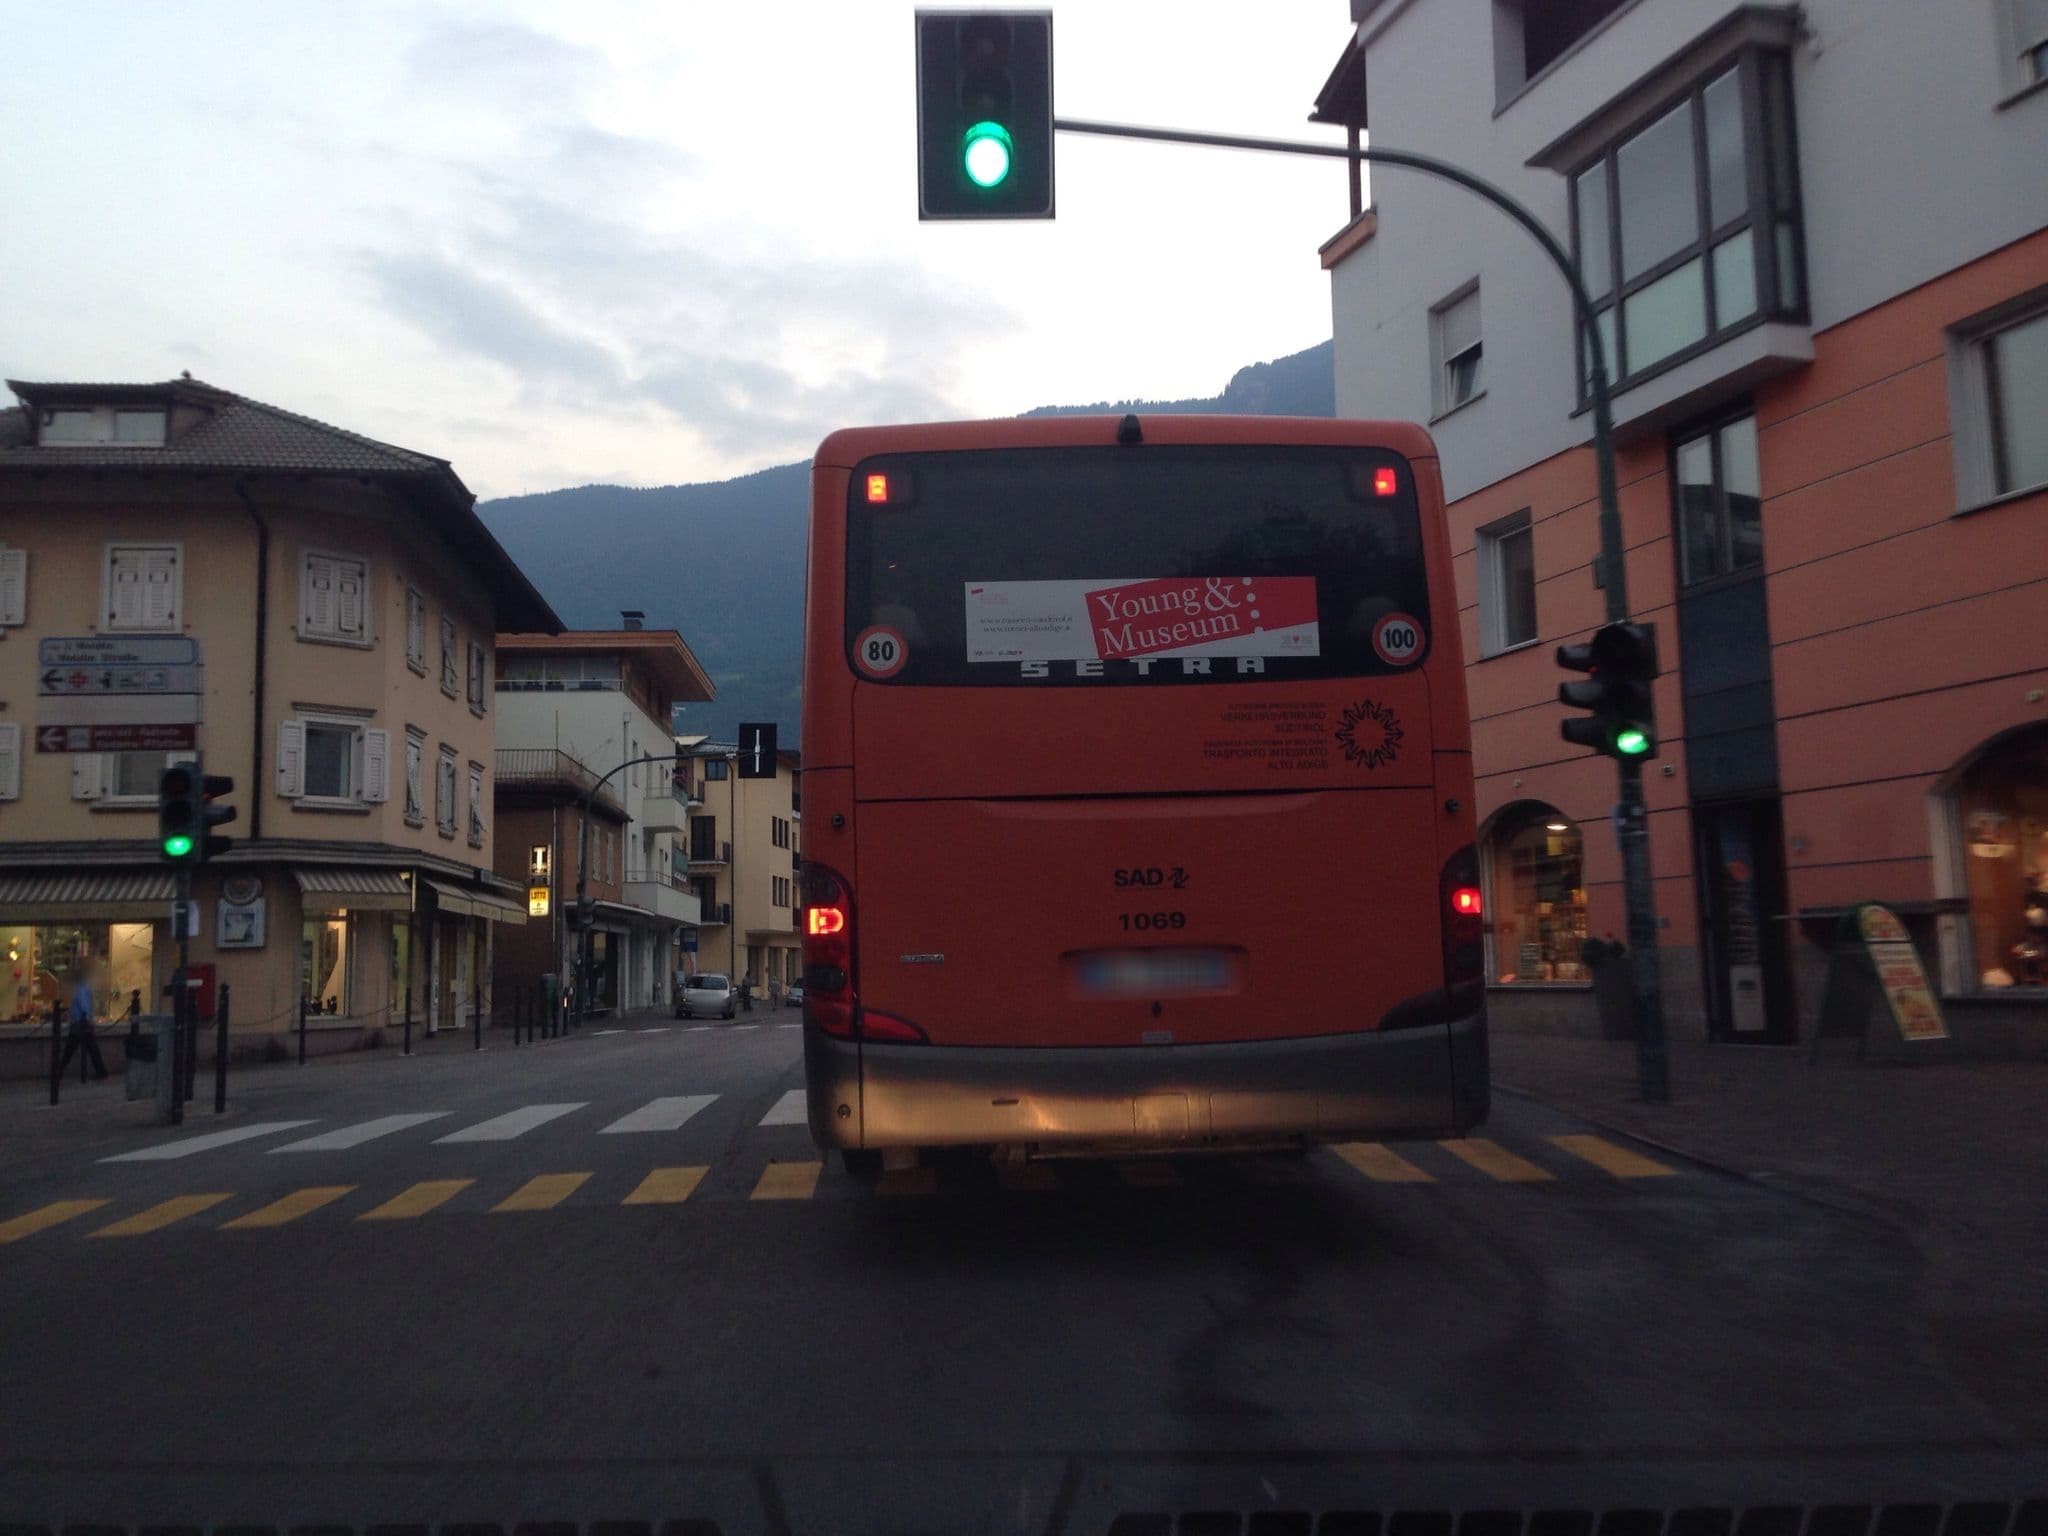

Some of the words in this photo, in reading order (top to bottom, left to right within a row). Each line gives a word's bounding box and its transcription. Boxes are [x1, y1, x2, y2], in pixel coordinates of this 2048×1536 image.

[1096, 576, 1241, 622] Young&
[1100, 612, 1241, 656] Museum
[1384, 628, 1416, 649] 100
[868, 640, 894, 661] 80
[1021, 656, 1265, 678] SETRA
[1113, 867, 1164, 887] SAD
[1117, 911, 1187, 931] 1069
